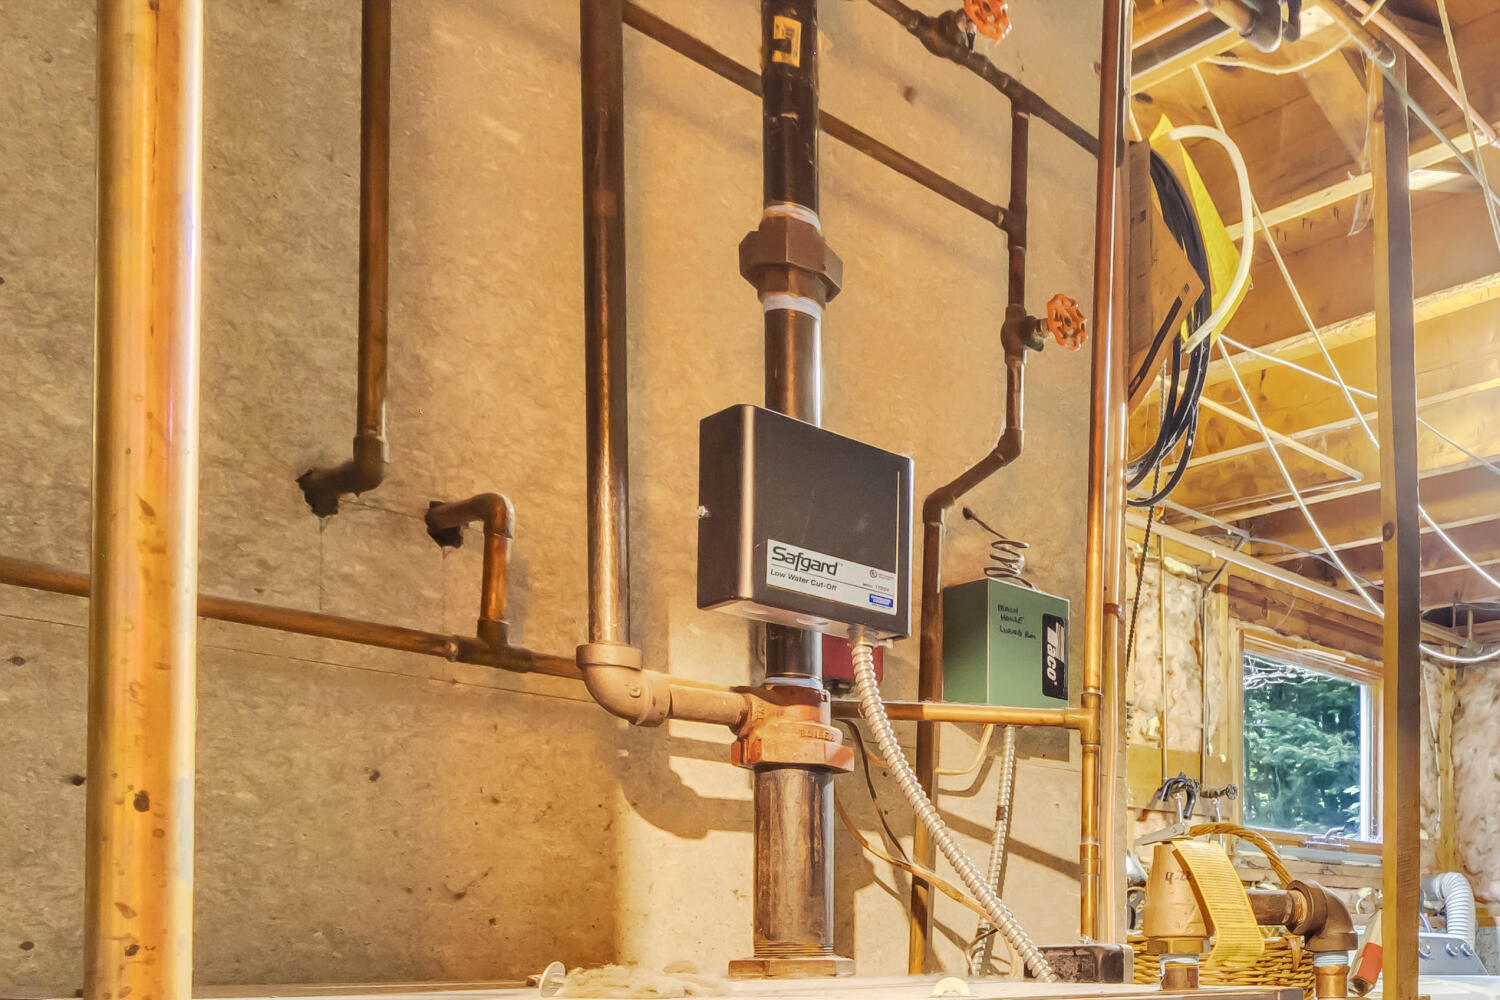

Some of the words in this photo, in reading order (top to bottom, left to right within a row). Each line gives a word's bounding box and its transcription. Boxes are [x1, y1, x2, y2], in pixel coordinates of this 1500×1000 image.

[771, 545, 838, 576] Safgard
[770, 568, 786, 579] Low
[788, 572, 809, 585] Water
[811, 578, 838, 592] Cut-Off
